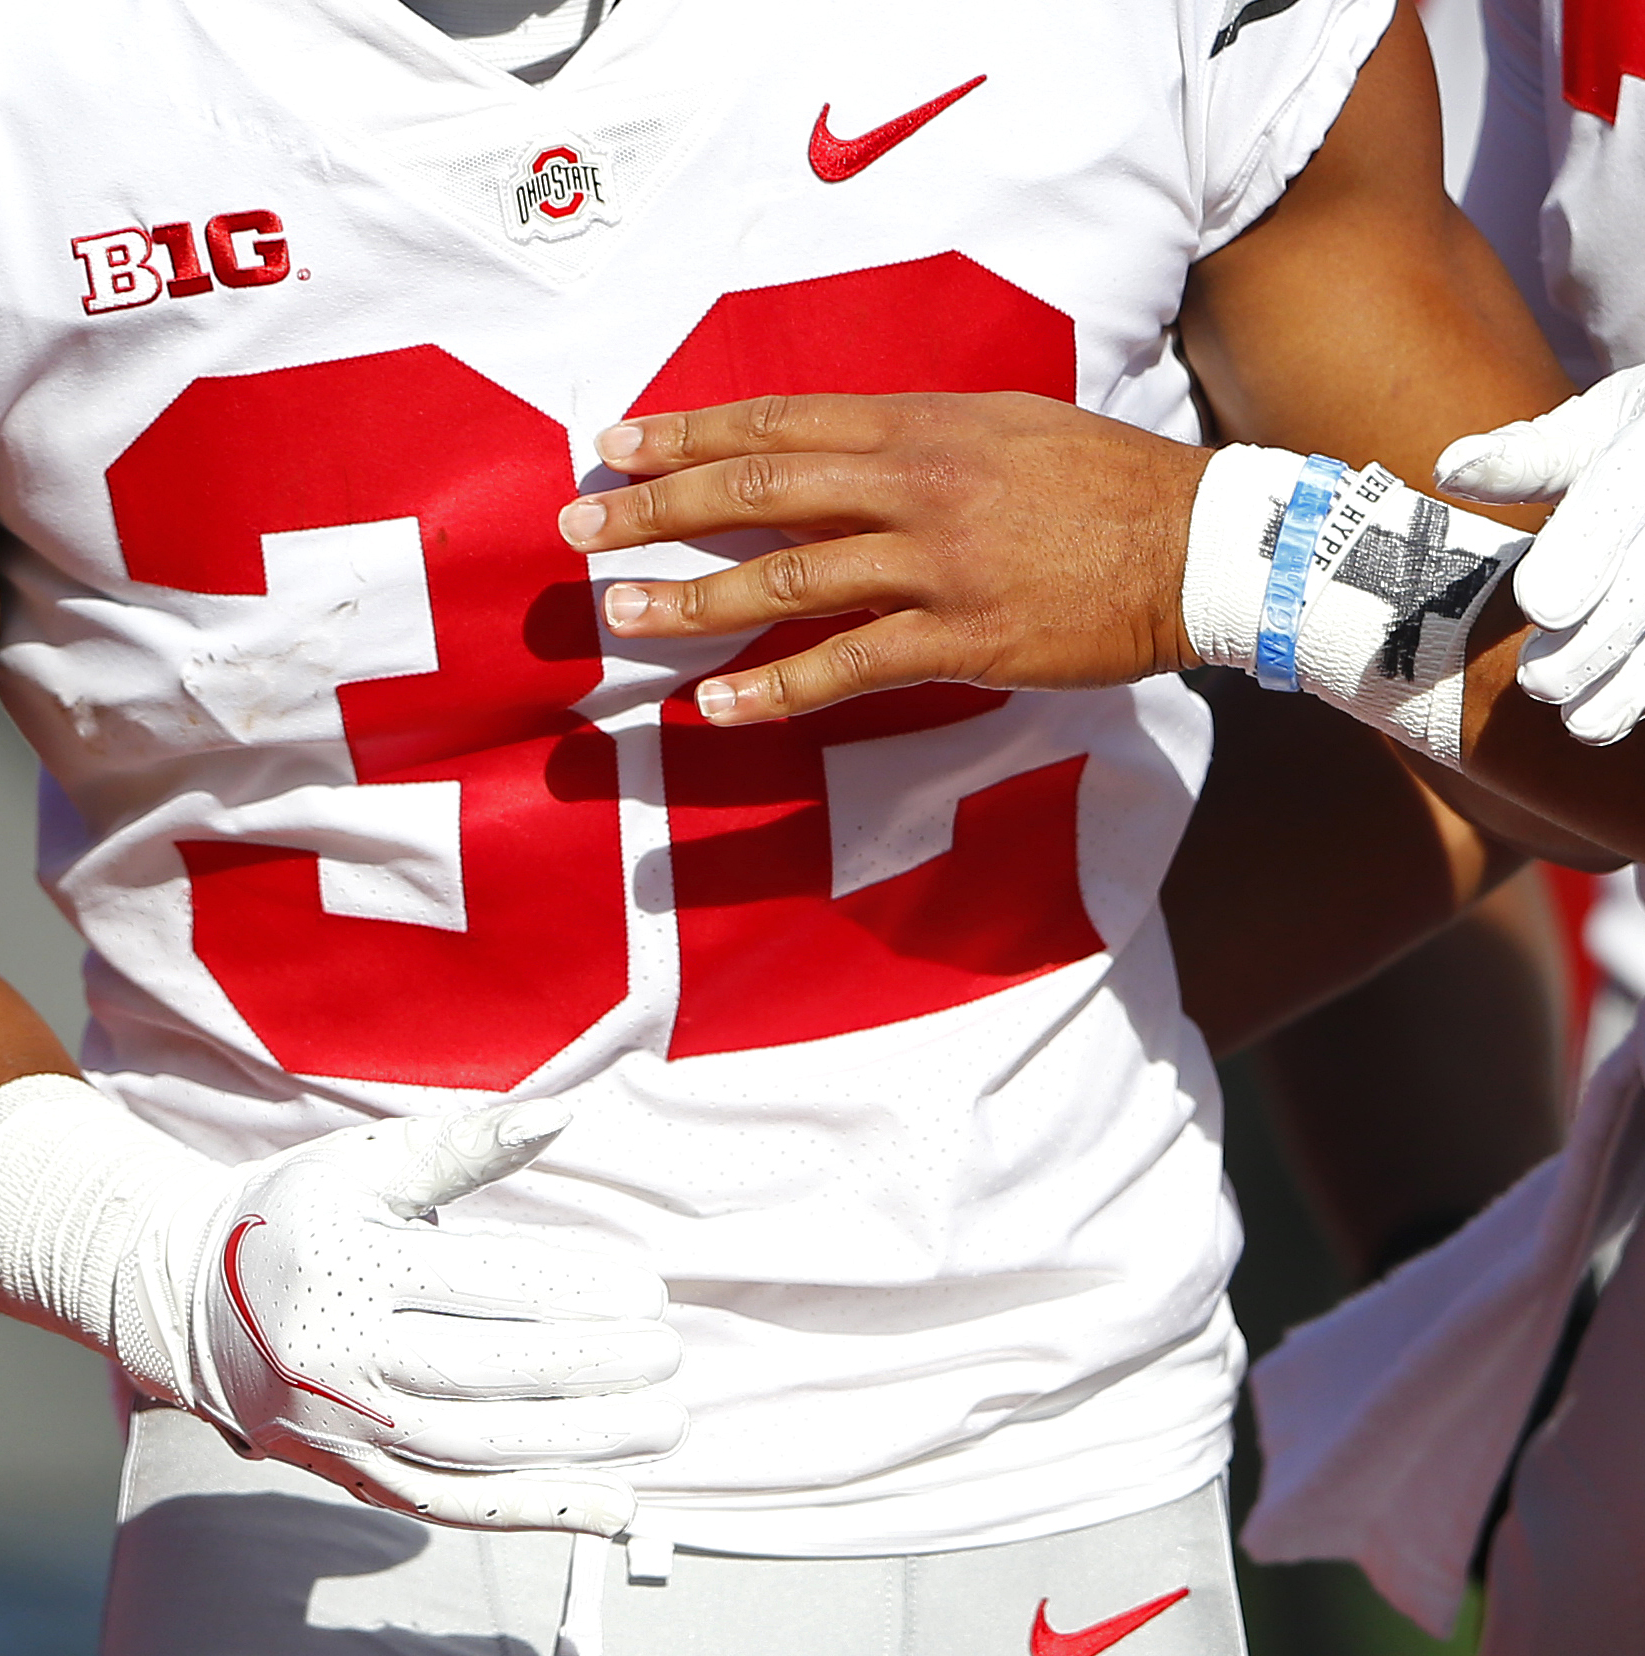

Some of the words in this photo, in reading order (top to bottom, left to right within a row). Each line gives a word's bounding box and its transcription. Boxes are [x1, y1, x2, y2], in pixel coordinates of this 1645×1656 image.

[516, 172, 552, 225] OHIO
[551, 164, 605, 204] STATE
[106, 249, 1110, 1092] 32
